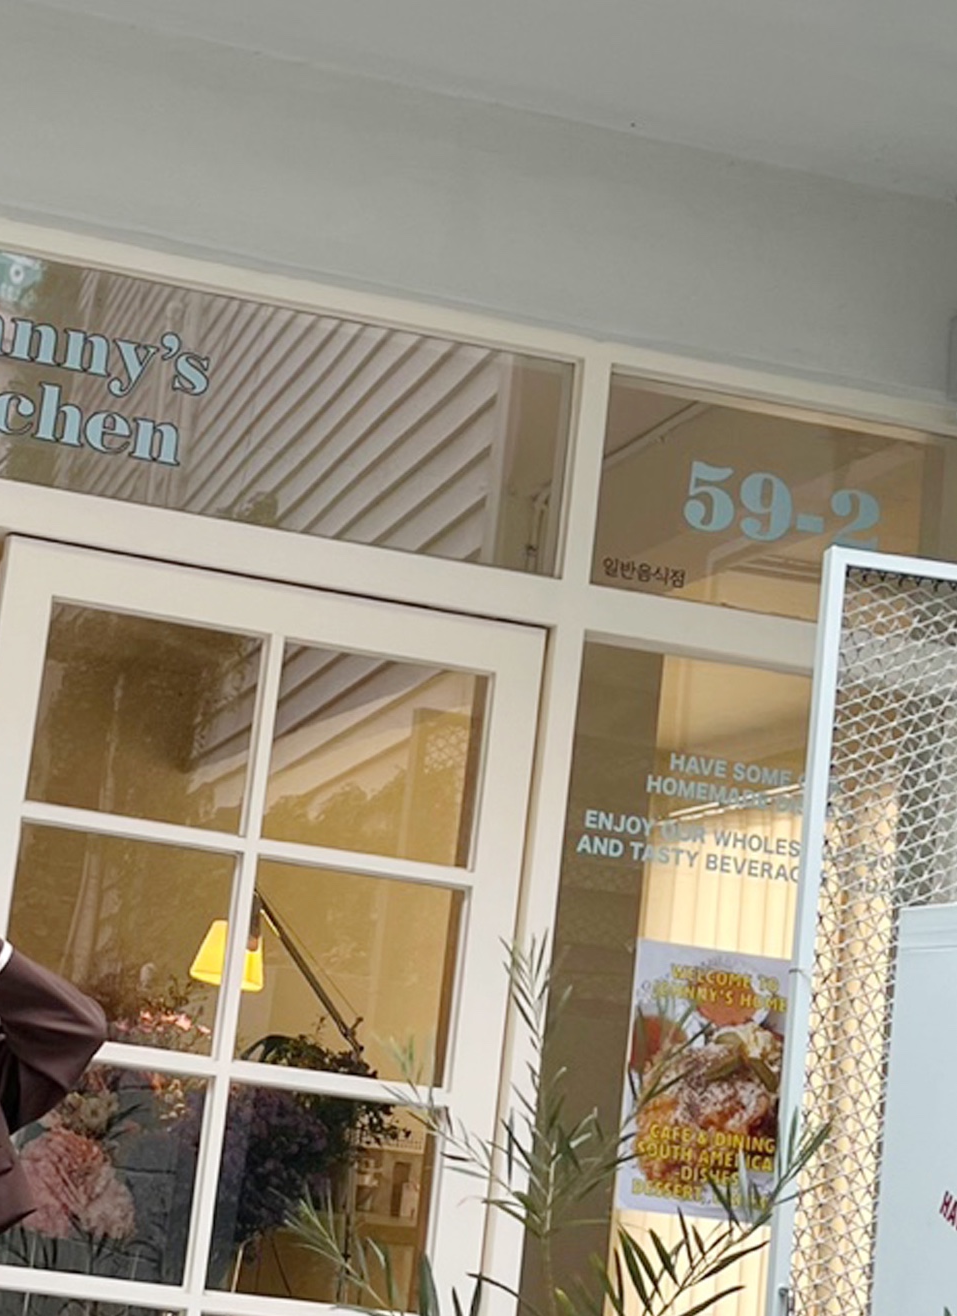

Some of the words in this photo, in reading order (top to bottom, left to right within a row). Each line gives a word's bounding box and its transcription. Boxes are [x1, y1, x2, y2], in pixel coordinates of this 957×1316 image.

[684, 460, 881, 550] 59-2
[602, 556, 686, 589] 일반음식점
[669, 752, 727, 778] HAVE
[733, 762, 793, 786] SOME
[584, 809, 656, 837] ENJOY
[713, 829, 801, 858] WHOLES
[576, 834, 624, 858] AND
[630, 841, 700, 868] TASTY
[670, 963, 752, 989] WELCOME
[758, 974, 780, 993] TO
[740, 993, 787, 1013] HOME
[636, 1140, 694, 1163] SOUTH
[649, 1122, 692, 1143] CAFE
[697, 1129, 708, 1145] &
[715, 1131, 776, 1154] DINING
